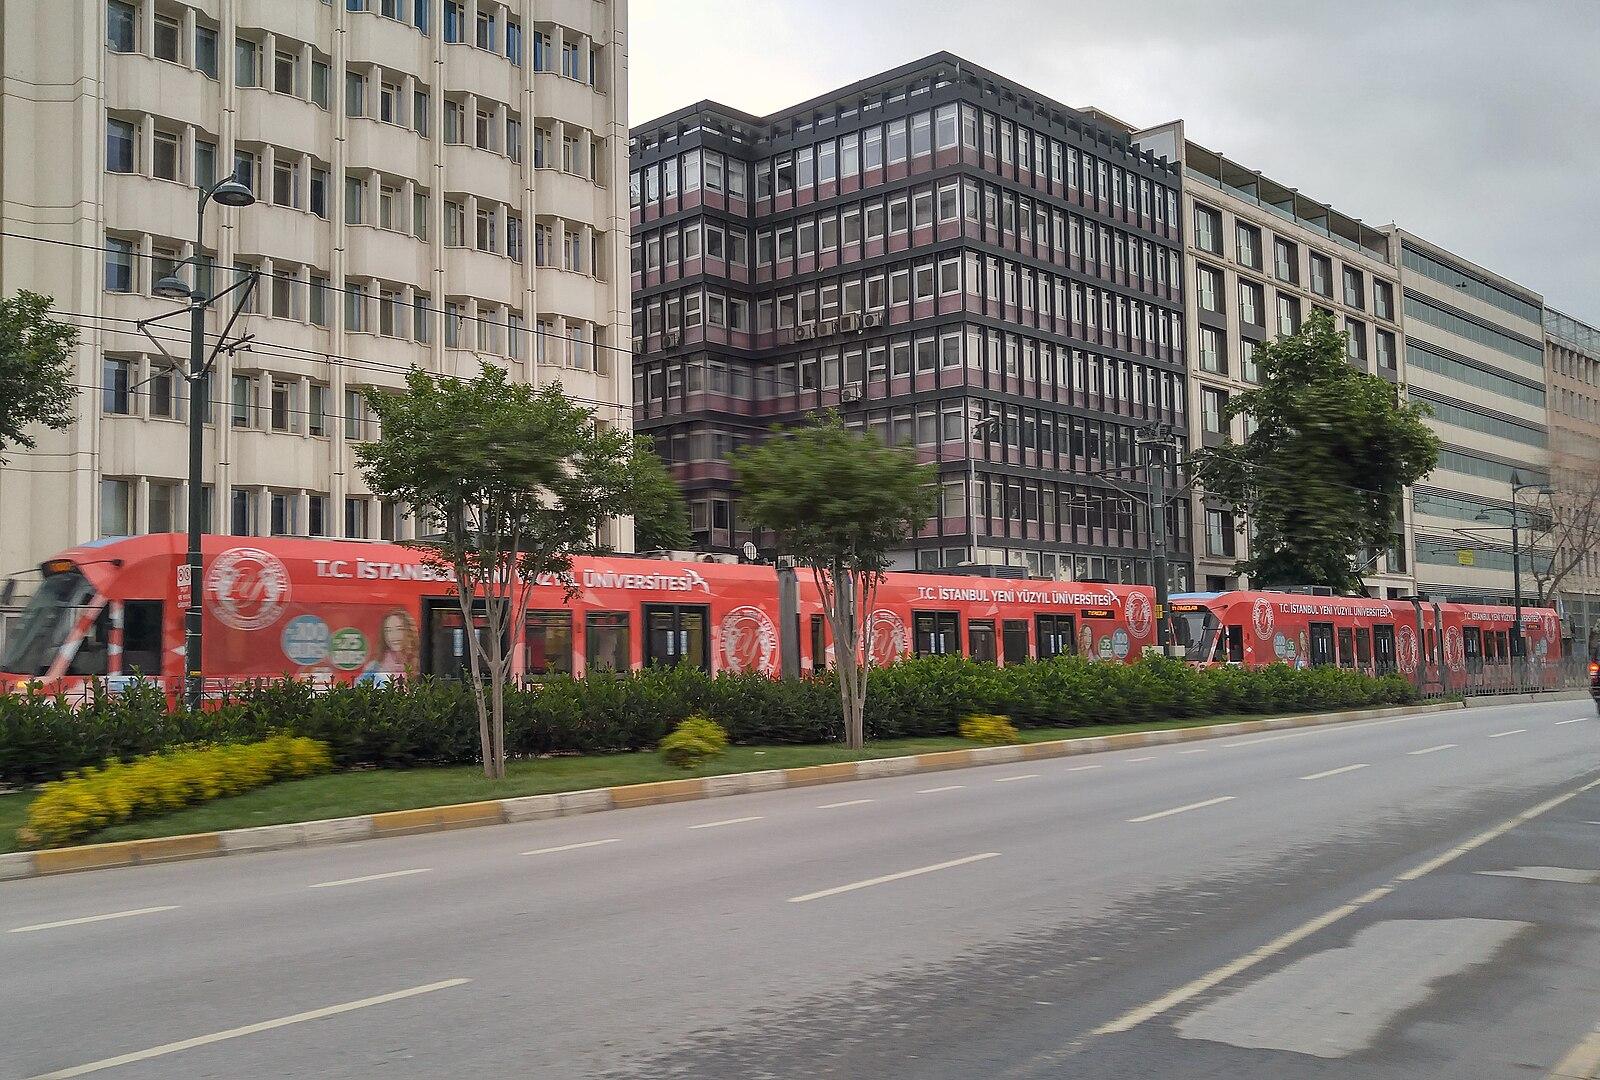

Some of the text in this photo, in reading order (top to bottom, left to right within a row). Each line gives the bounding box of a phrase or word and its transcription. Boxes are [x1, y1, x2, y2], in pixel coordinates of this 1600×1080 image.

[583, 568, 692, 592] ÜNİVERSİTESİ
[917, 585, 1112, 606] T.C. İSTANBUL YENİ YÜZYIL ÜNİVERSİTESİ
